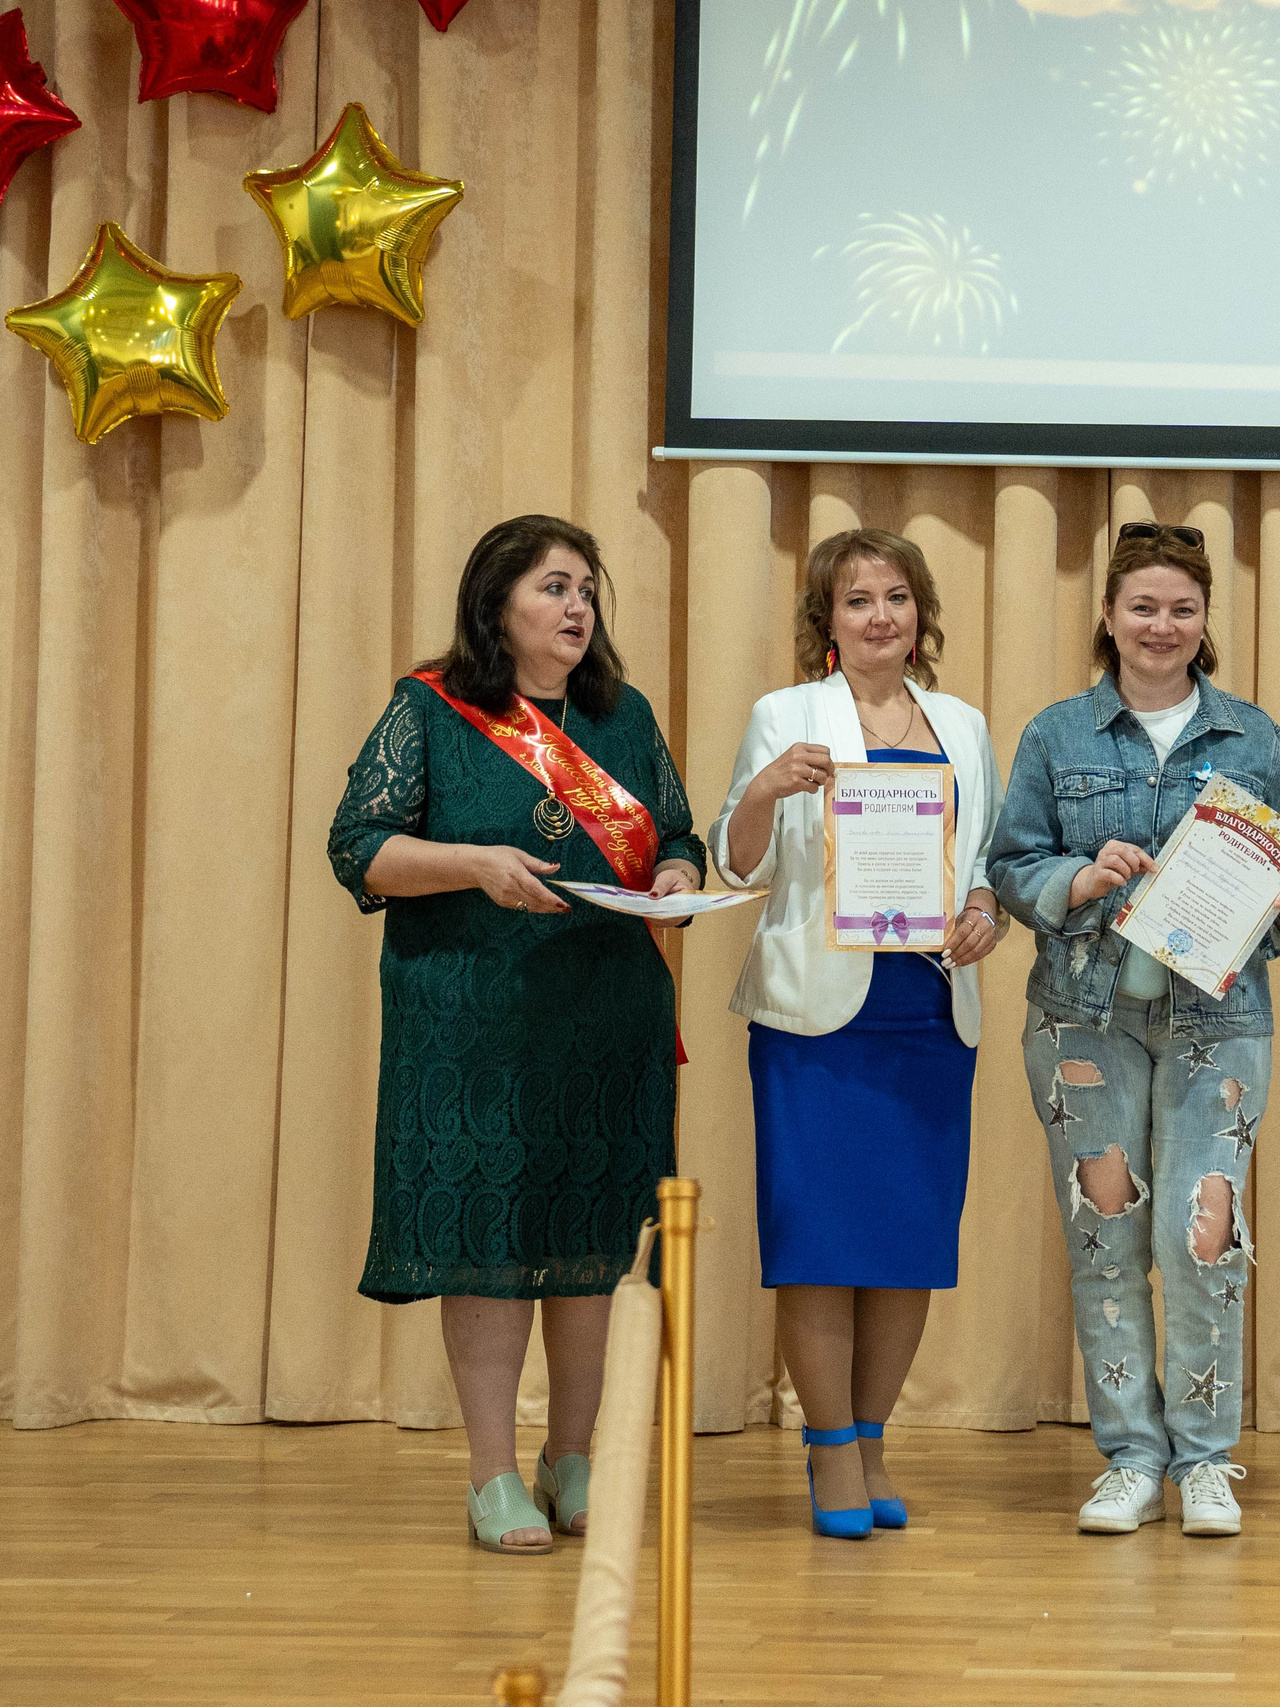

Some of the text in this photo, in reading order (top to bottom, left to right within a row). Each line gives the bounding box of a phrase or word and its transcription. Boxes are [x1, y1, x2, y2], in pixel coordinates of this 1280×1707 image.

[524, 729, 614, 810] Классный
[579, 760, 648, 833] Швец Татьяна
[841, 788, 937, 799] БЛАГОДАРНОСТЬ
[864, 803, 914, 813] РОДИТЕЛЯМ
[1218, 830, 1267, 866] РОДИТЕЛЯМ
